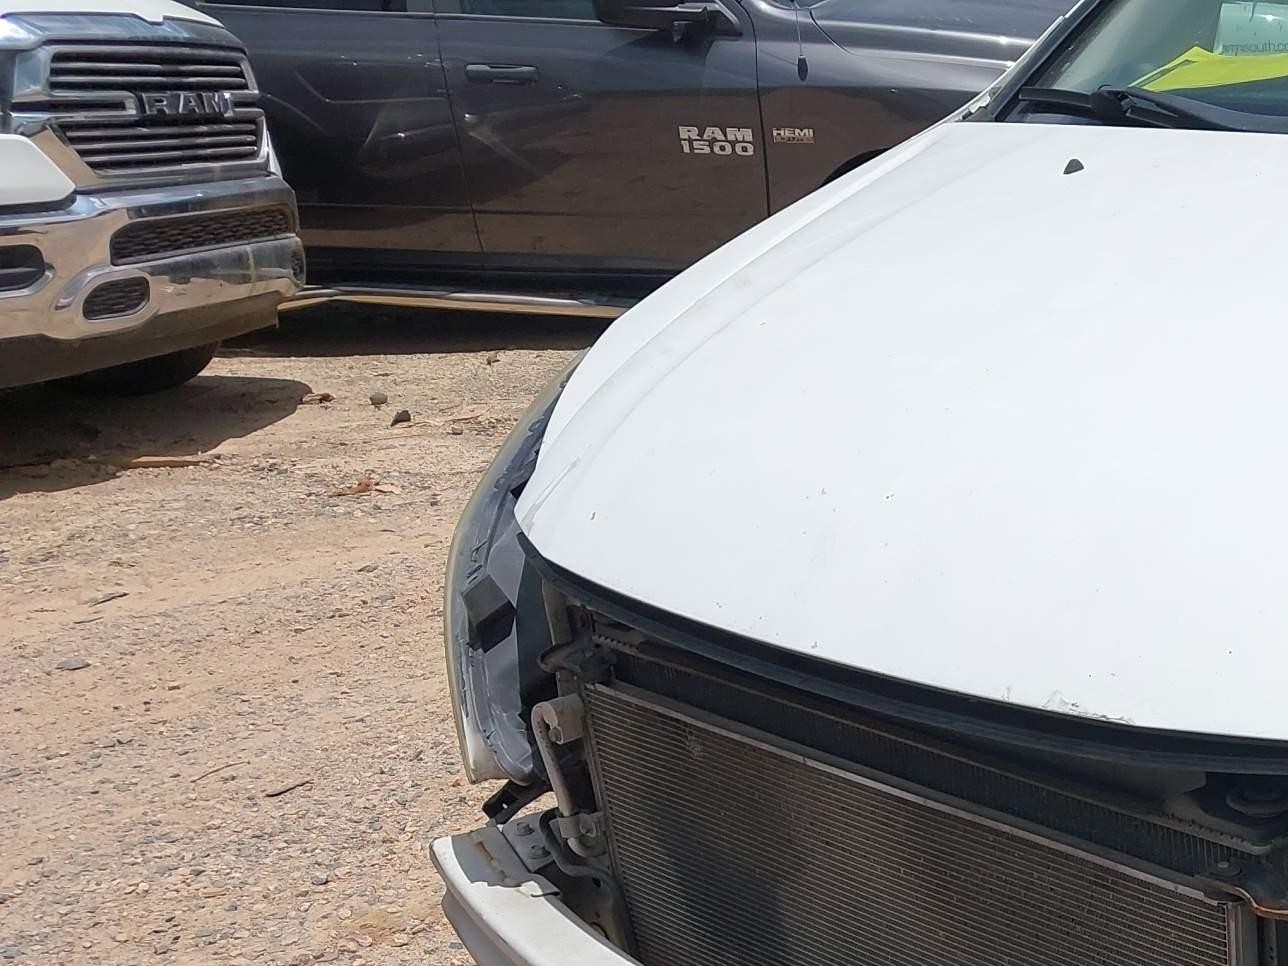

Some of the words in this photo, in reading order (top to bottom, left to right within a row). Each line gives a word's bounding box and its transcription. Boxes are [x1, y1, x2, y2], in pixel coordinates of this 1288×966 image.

[142, 91, 233, 116] RAM
[678, 126, 753, 141] RAM
[772, 127, 814, 137] HEMI
[681, 140, 754, 156] 1500
